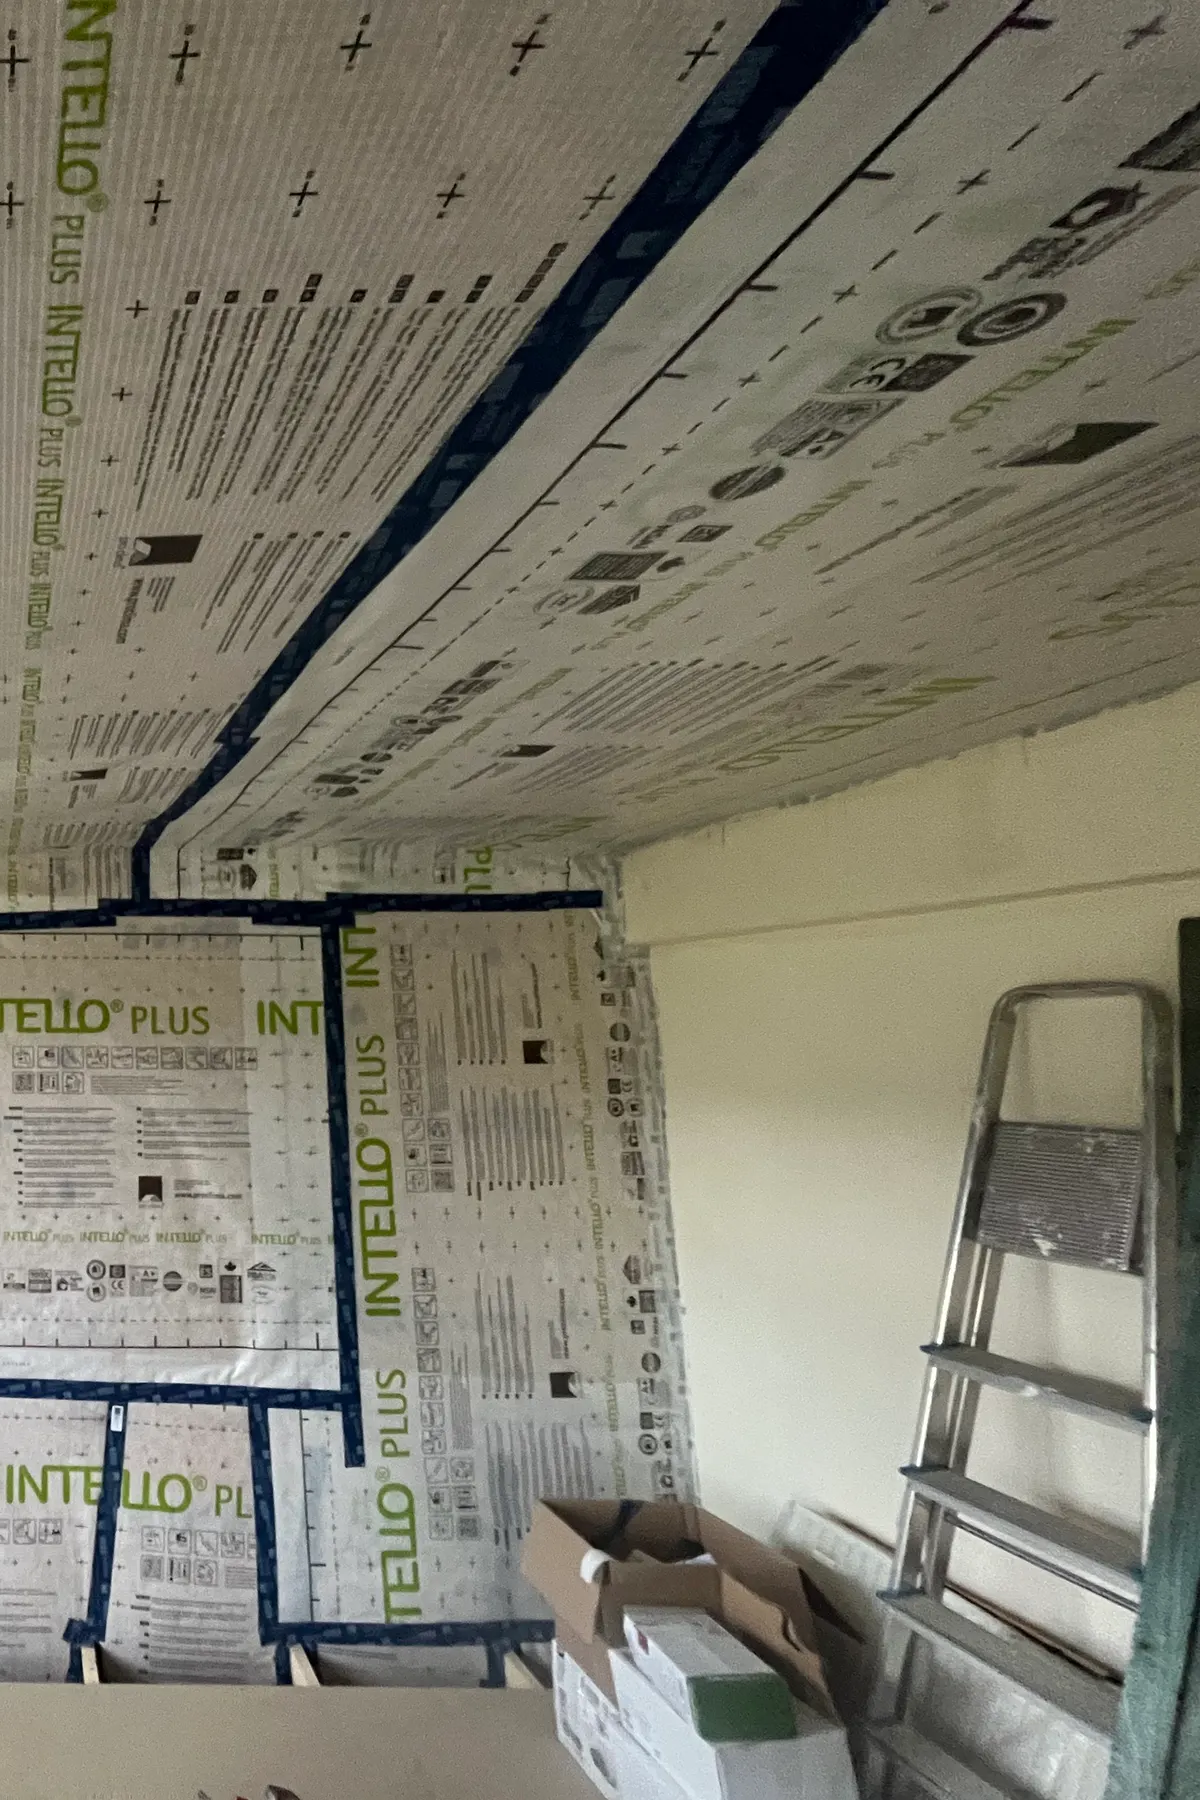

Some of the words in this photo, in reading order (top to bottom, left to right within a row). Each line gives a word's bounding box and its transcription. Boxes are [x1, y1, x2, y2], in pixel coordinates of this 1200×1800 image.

[49, 214, 85, 285] PLUS
[37, 428, 65, 469] PLUS
[131, 1005, 211, 1036] PLUS
[257, 1000, 324, 1036] INT
[355, 1035, 389, 1116] PLUS
[111, 1279, 125, 1291] CE
[376, 1369, 410, 1458] PLUS
